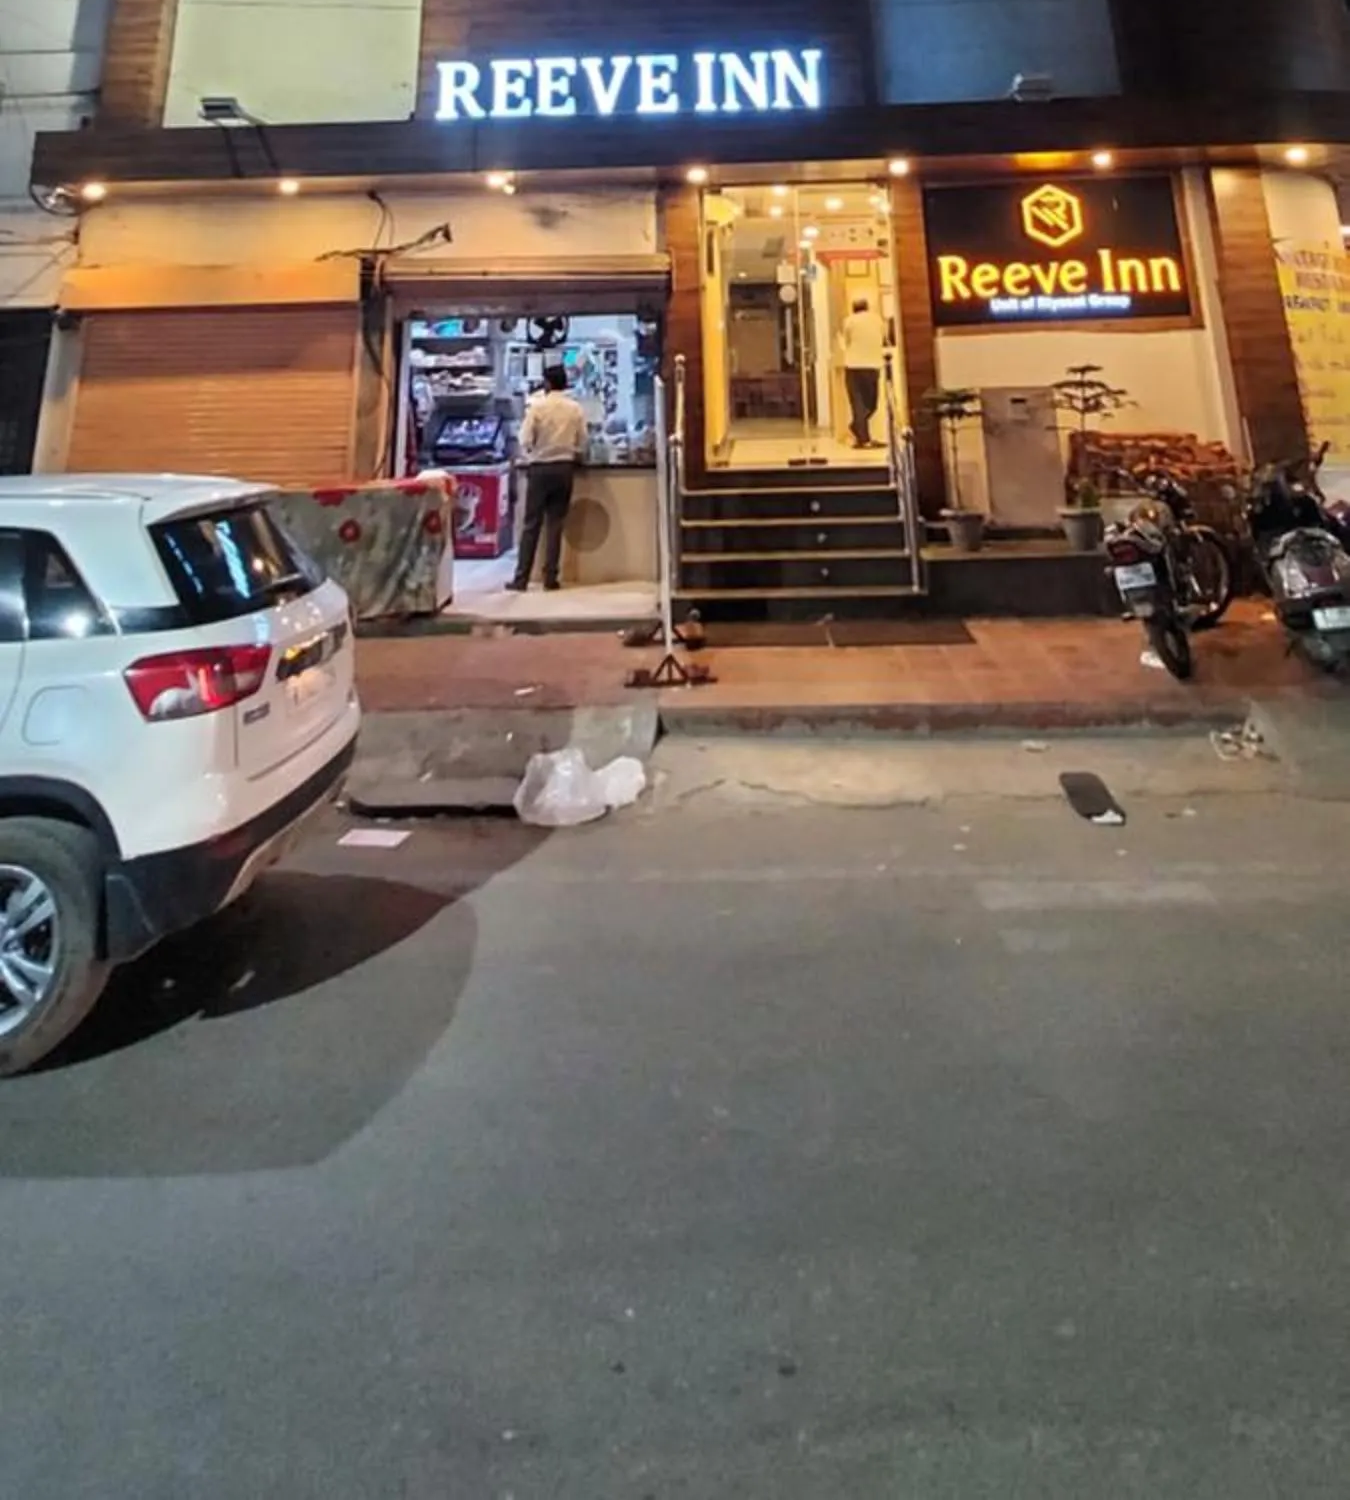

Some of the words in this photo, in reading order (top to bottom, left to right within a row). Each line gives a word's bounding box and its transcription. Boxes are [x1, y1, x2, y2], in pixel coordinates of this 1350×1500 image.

[435, 53, 679, 120] REEVE
[694, 49, 822, 112] INN
[937, 254, 1088, 302] Reeve
[1097, 248, 1182, 293] Inn
